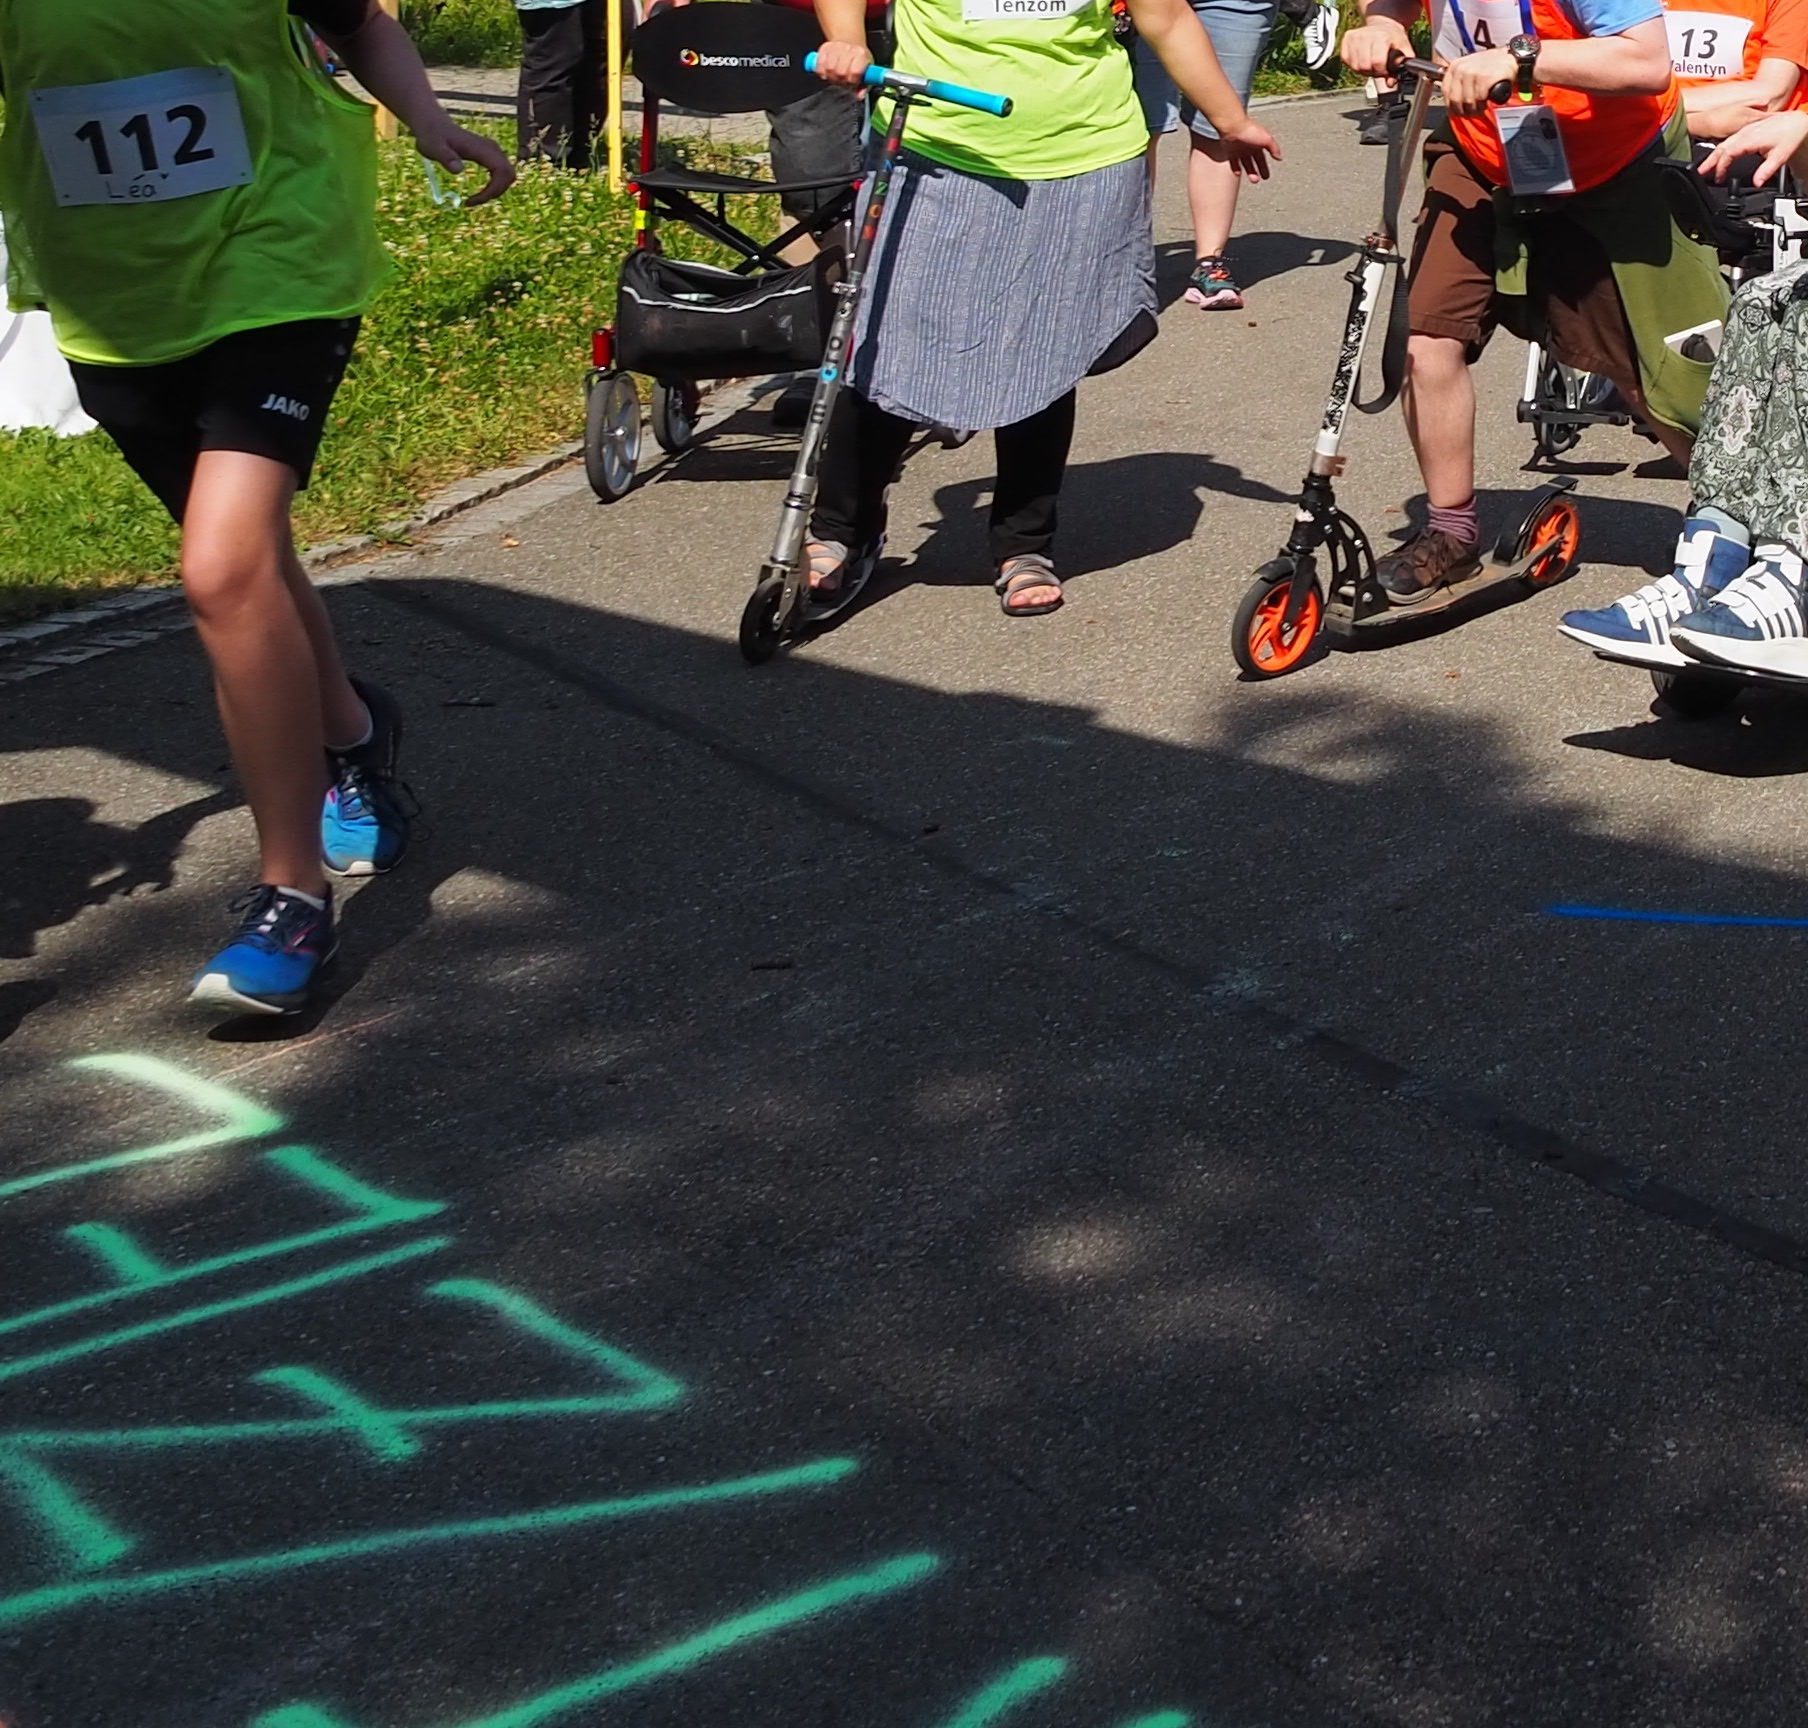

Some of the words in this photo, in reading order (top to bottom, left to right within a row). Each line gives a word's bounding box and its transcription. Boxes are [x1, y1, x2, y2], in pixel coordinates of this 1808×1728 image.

[1680, 28, 1719, 60] 13
[74, 104, 216, 176] 112
[259, 393, 310, 422] JAKO
